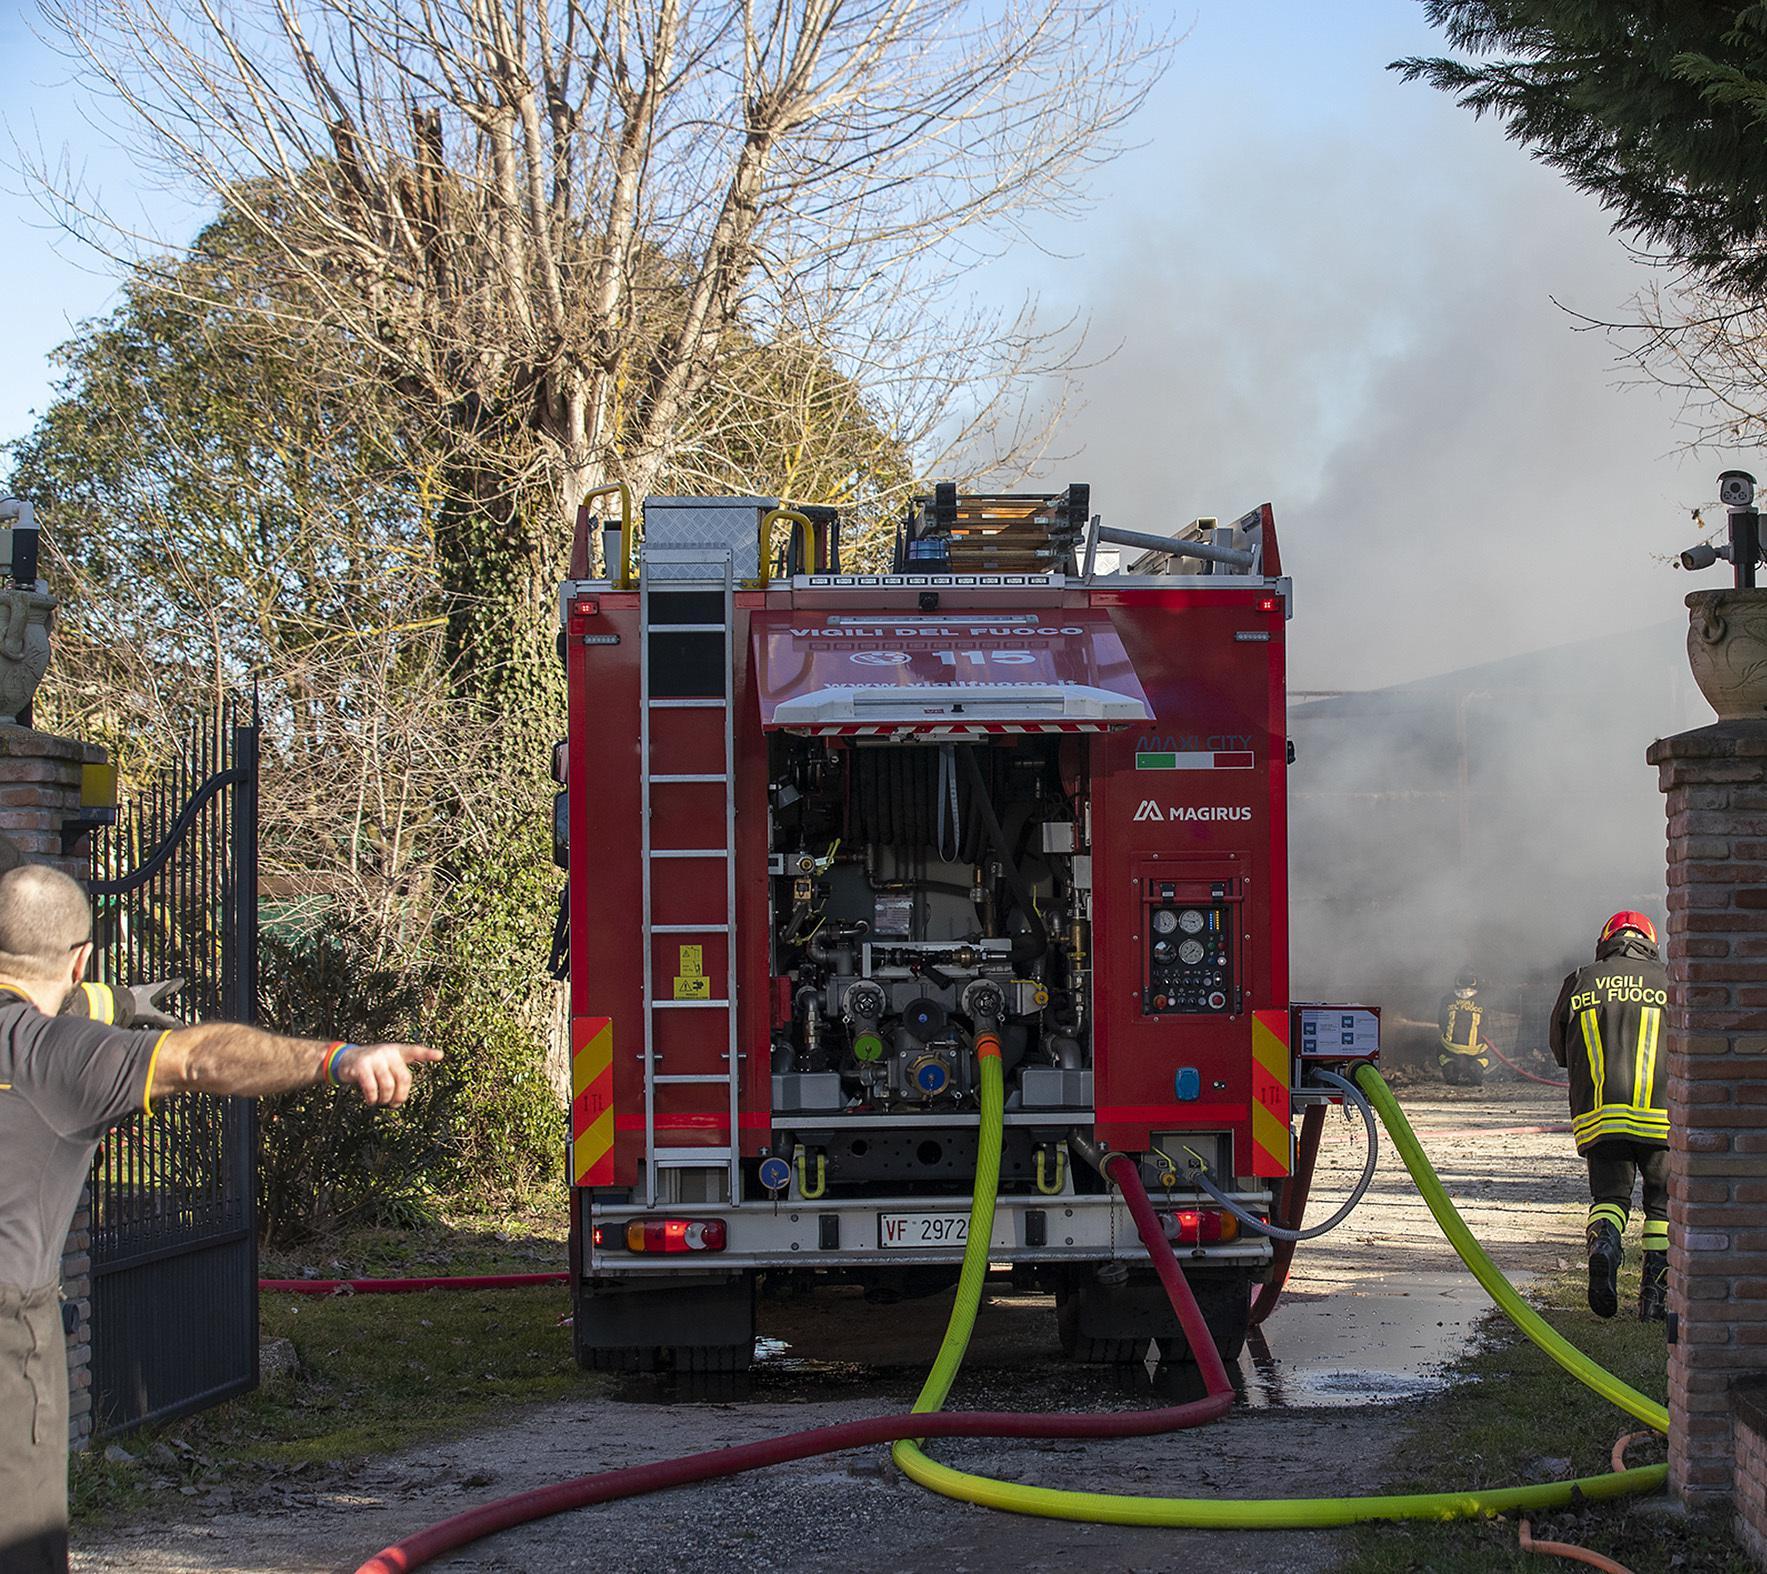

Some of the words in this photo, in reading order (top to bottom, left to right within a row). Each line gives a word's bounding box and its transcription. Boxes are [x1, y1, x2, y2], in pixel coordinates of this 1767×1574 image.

[789, 628, 883, 637] VIGILI
[895, 628, 959, 637] DEL
[970, 627, 1084, 637] FUOCO
[932, 650, 1037, 665] 115
[1136, 735, 1199, 751] MAXI
[1206, 735, 1252, 751] CITY
[1169, 807, 1252, 821] MAGIRUS
[1595, 975, 1644, 990] VIGILI
[1570, 990, 1601, 1011] DEL
[1607, 988, 1668, 1006] FUOCO
[885, 1219, 908, 1241] VF
[920, 1218, 971, 1241] 2972
